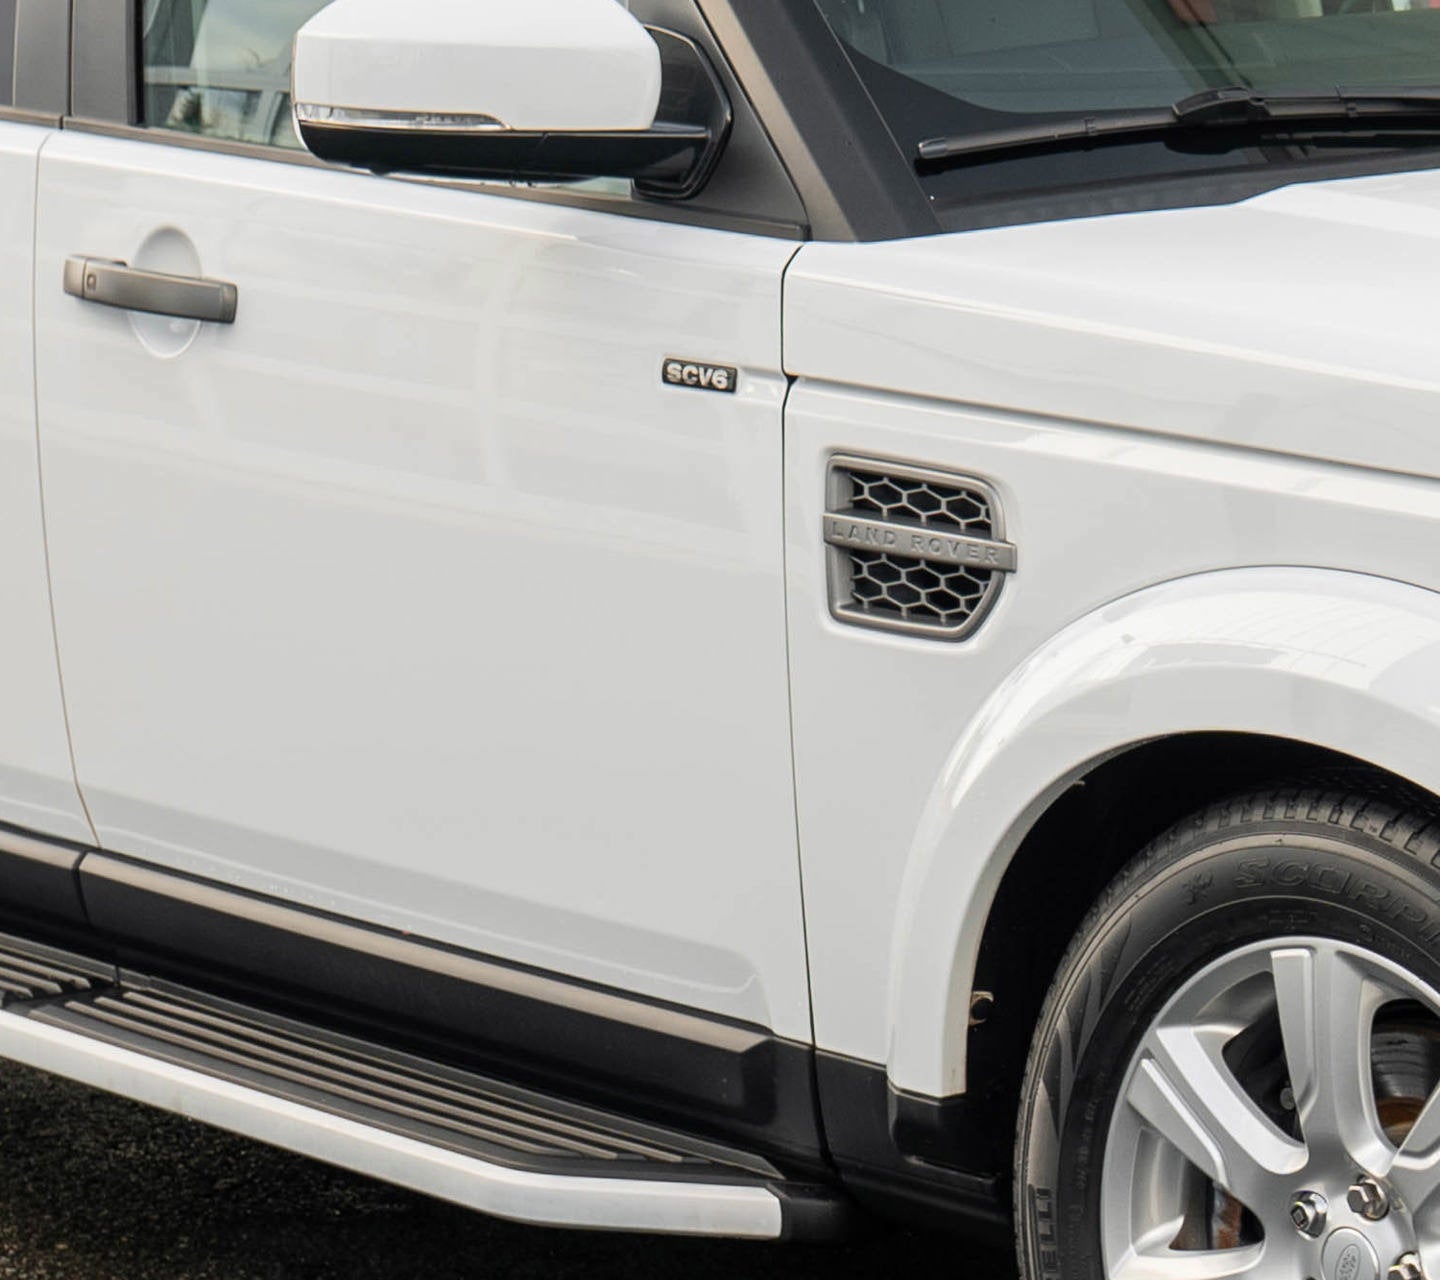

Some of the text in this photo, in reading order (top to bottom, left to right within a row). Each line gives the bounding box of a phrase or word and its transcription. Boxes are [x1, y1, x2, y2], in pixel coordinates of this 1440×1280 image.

[666, 362, 729, 390] SCV6
[831, 519, 1001, 566] LAND ROVER
